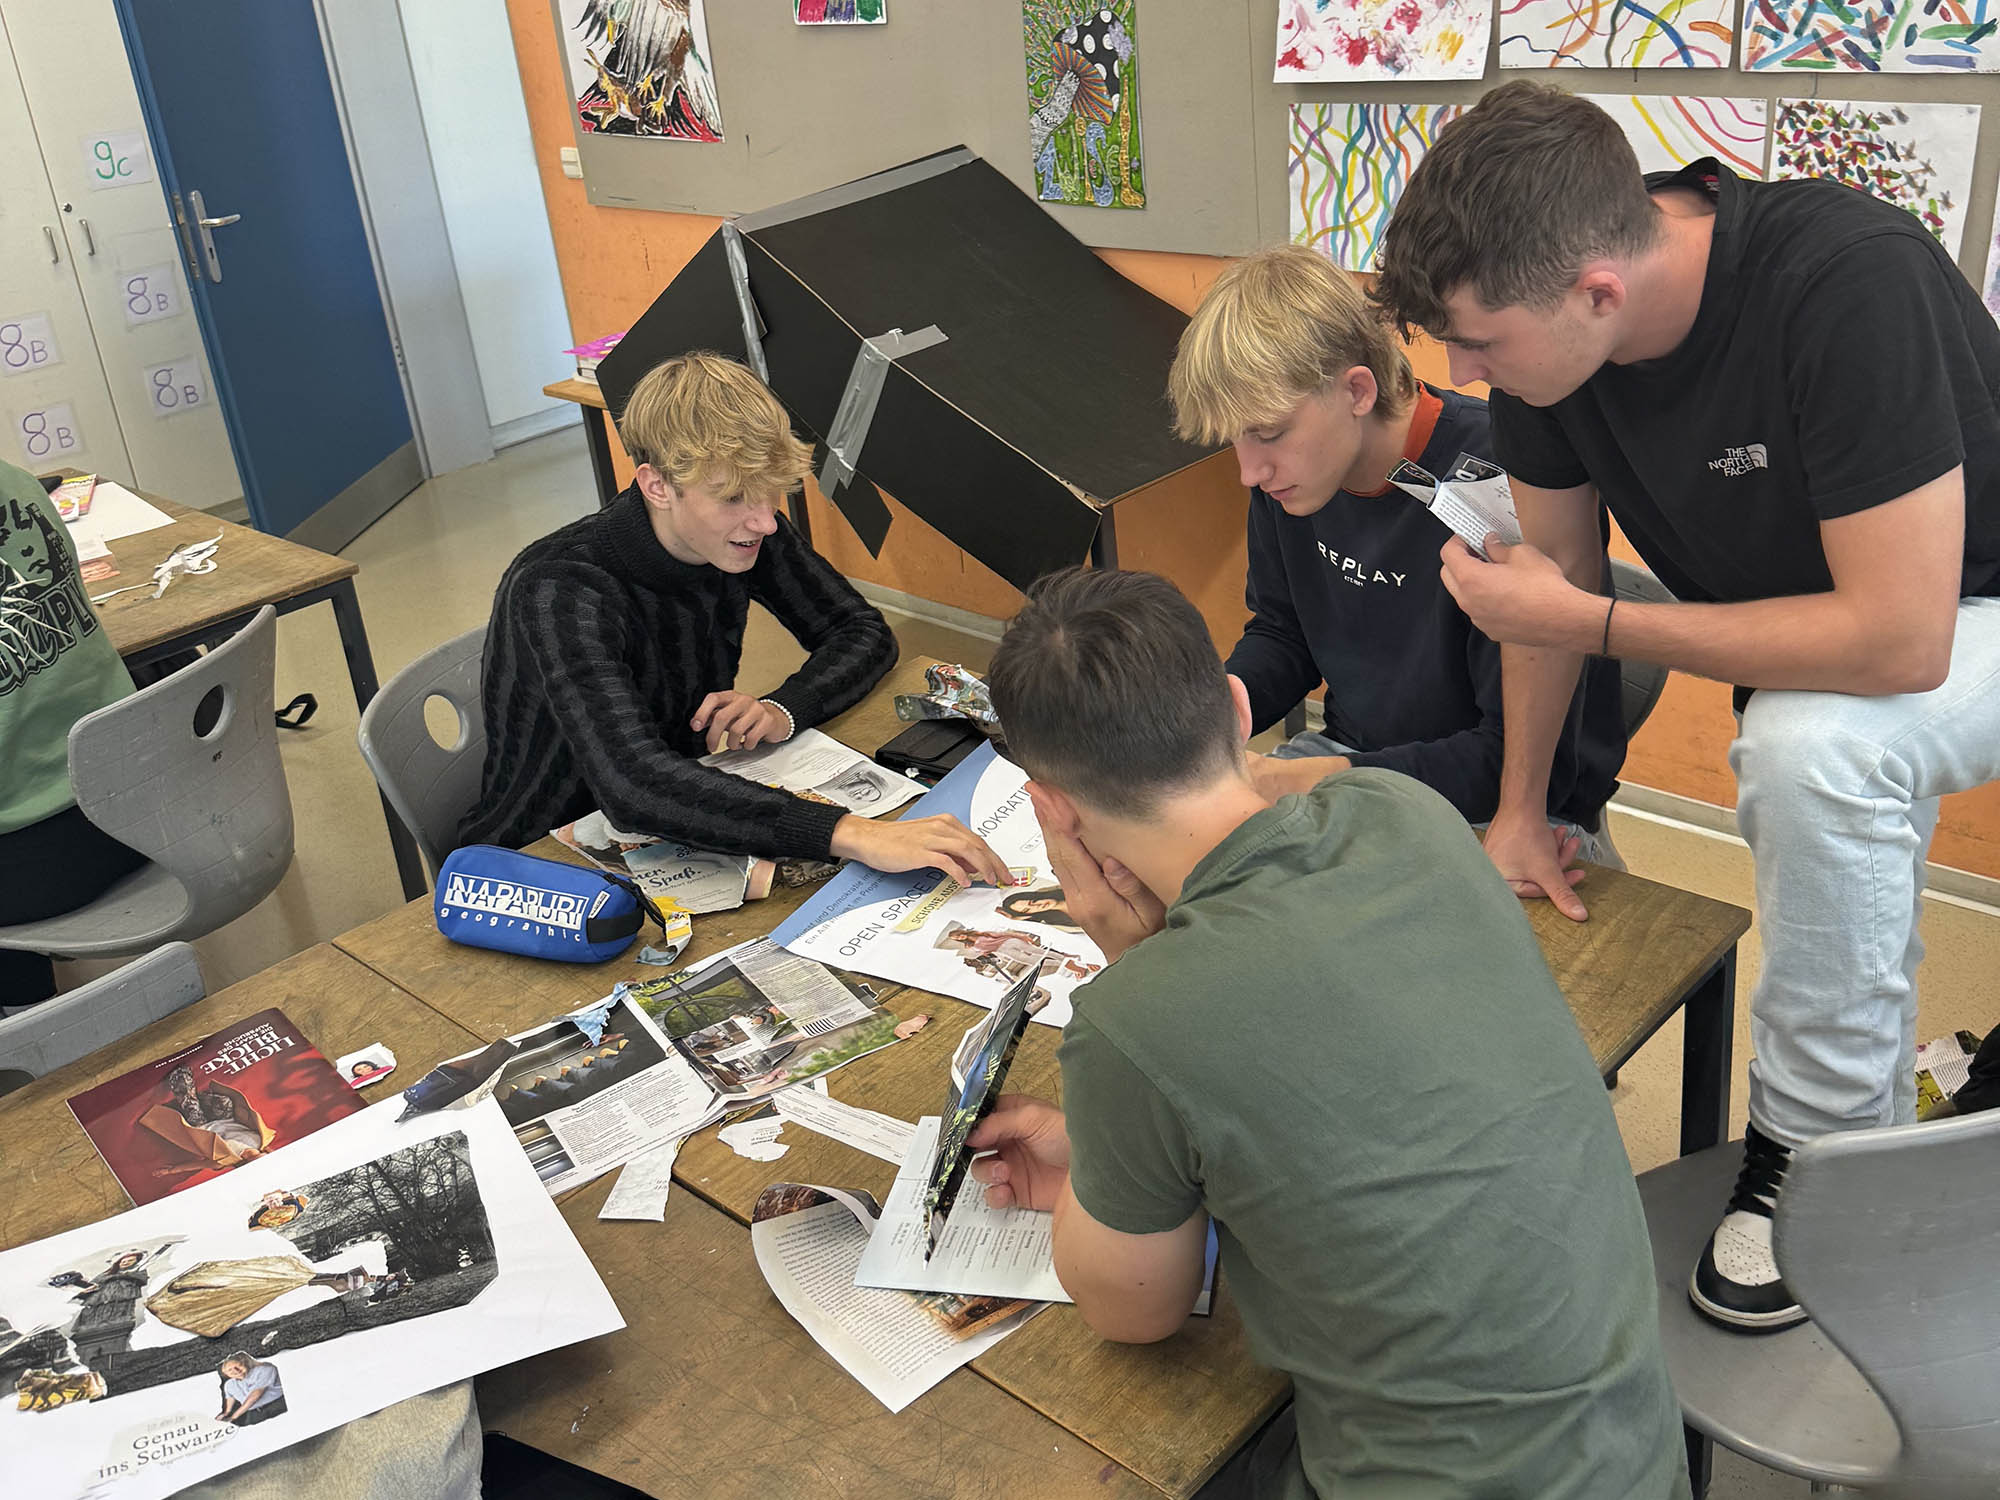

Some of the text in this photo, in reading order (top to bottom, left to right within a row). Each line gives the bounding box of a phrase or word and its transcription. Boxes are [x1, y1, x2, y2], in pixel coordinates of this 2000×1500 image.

[127, 277, 169, 315] 8B
[0, 323, 48, 367] 8B
[153, 368, 200, 407] 8B
[23, 411, 75, 455] 8B
[1724, 447, 1747, 458] THE
[1707, 455, 1751, 470] NORTH
[1723, 462, 1755, 477] FACE
[1317, 540, 1406, 587] REPLAY
[839, 881, 932, 957] OPEN SPACE
[199, 1030, 280, 1075] BLICKE
[223, 1035, 296, 1075] LICHT-
[98, 1459, 129, 1479] ins
[136, 1424, 236, 1467] Schwarze
[132, 1422, 201, 1451] Genau
